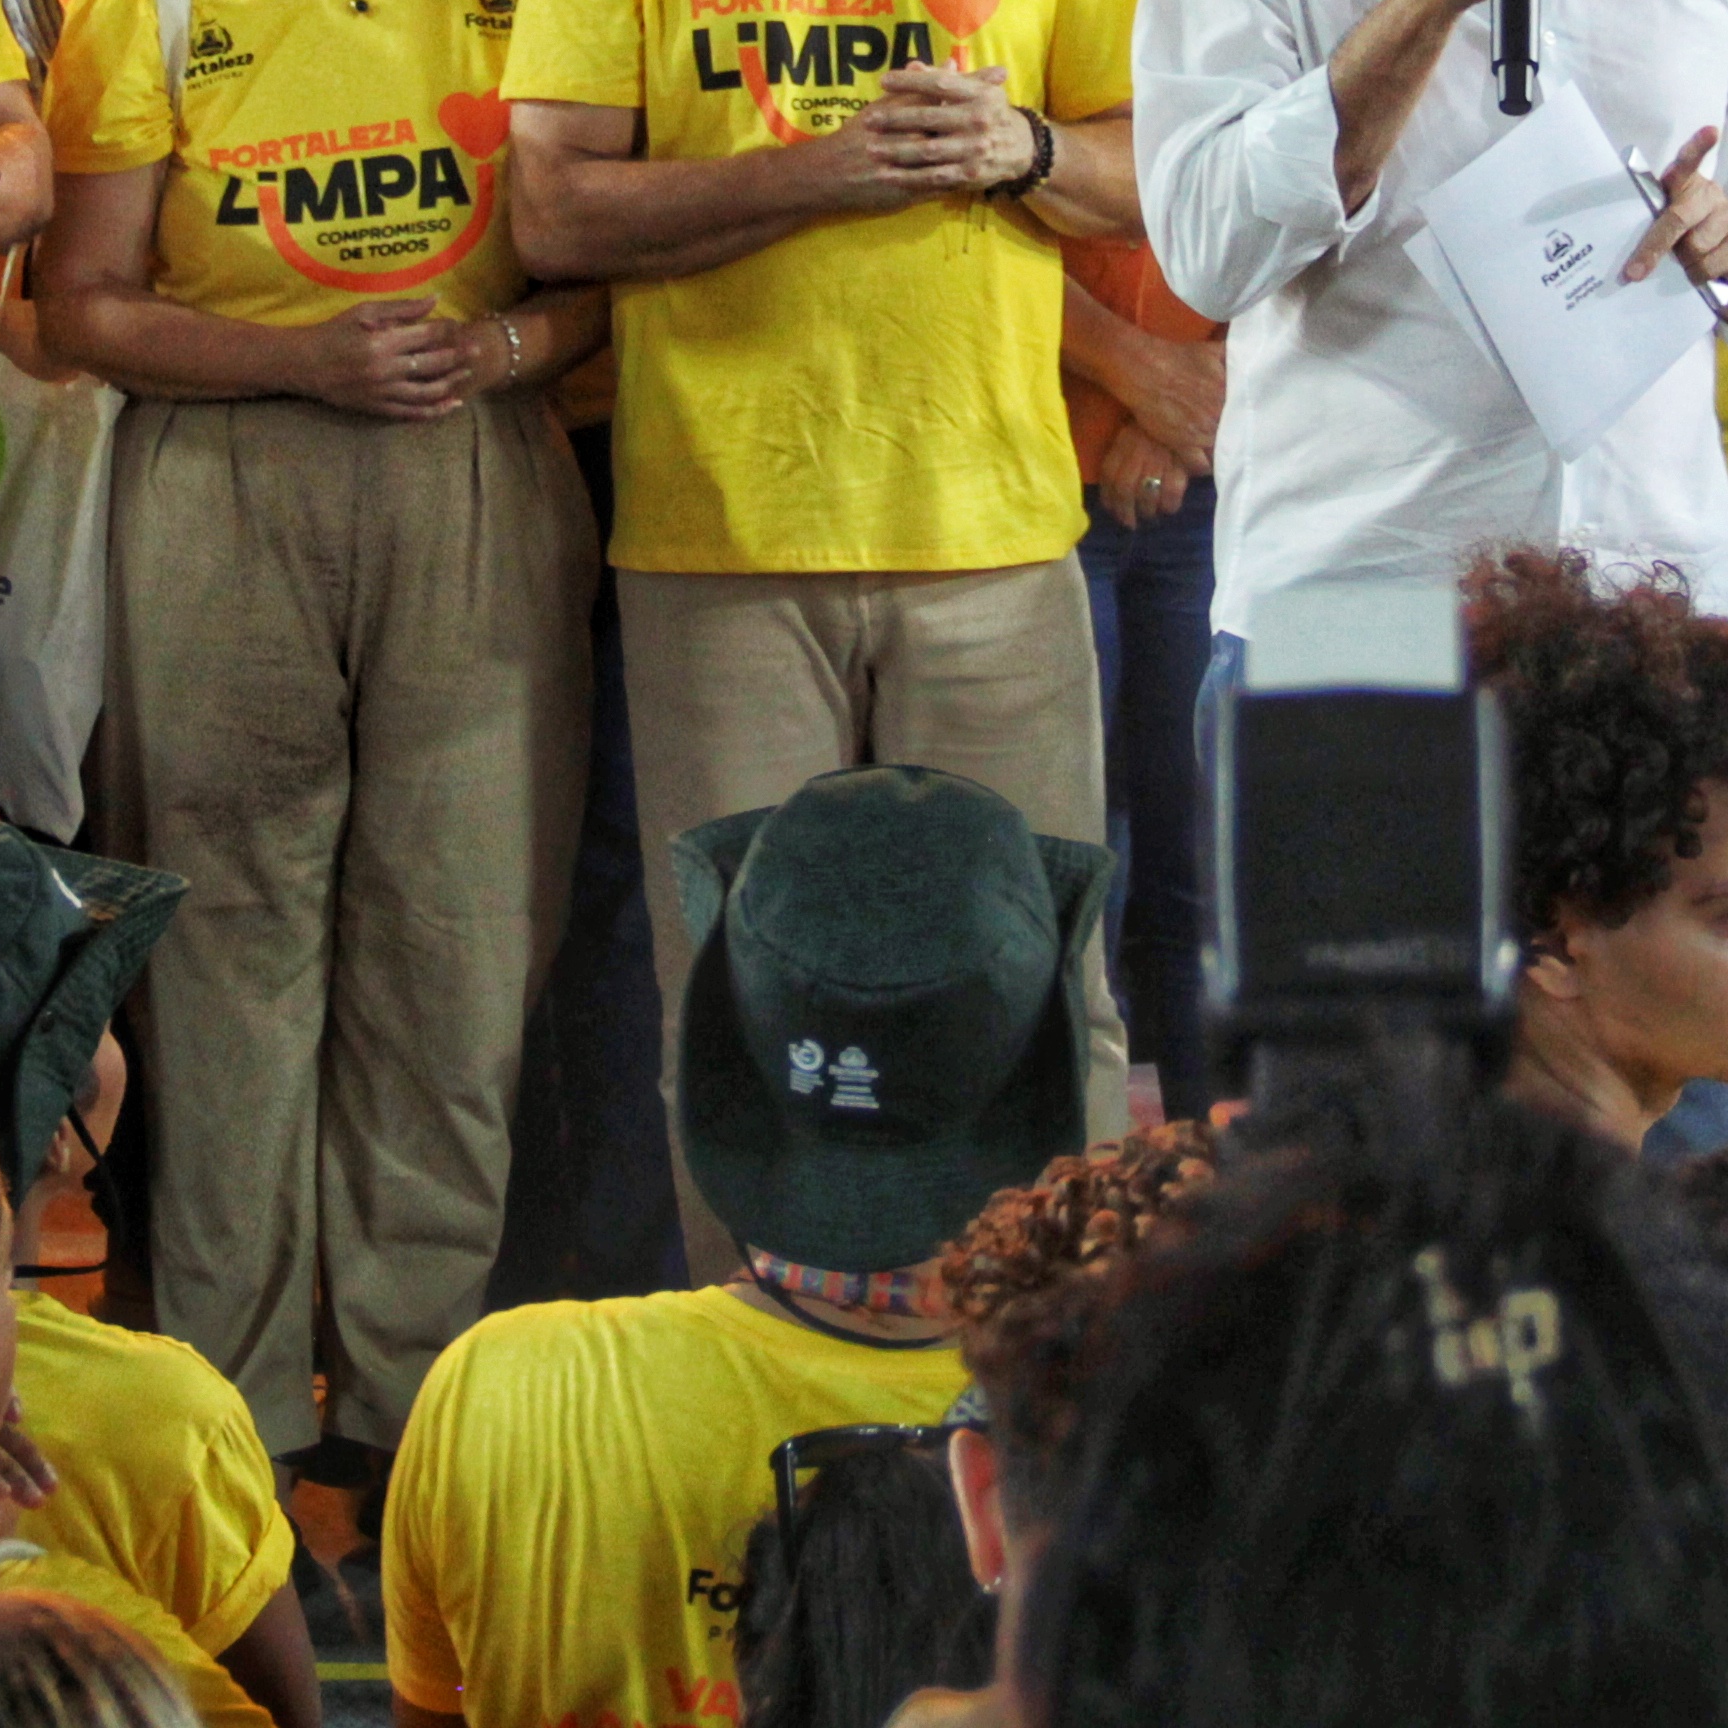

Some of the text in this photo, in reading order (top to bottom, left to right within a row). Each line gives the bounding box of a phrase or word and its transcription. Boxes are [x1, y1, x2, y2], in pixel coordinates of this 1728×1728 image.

[810, 113, 835, 128] DE
[208, 117, 418, 173] FORTALEZA
[316, 217, 453, 248] COMPROMISSO
[339, 238, 430, 263] DE TODOS
